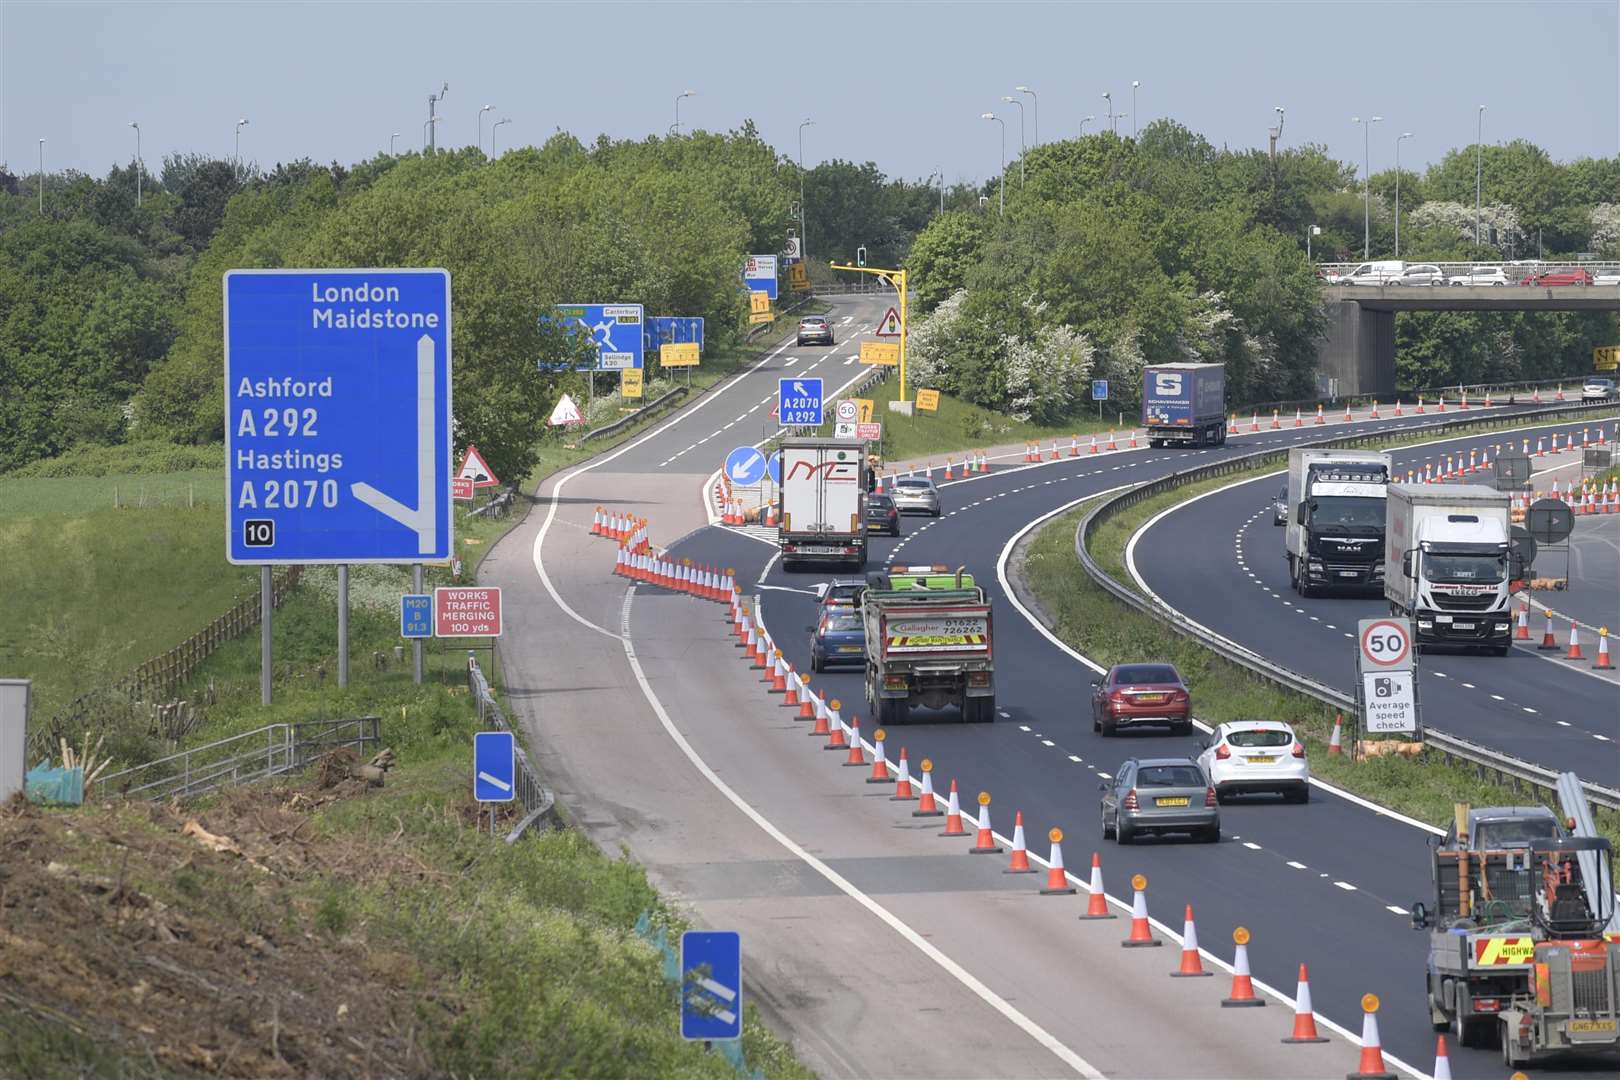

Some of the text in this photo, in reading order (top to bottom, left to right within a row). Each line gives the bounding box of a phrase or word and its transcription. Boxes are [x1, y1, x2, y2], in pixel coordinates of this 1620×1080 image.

[312, 282, 400, 303] London
[312, 308, 440, 329] Maidstone
[604, 354, 632, 362] Sellindge
[237, 377, 333, 398] Ashford
[841, 406, 854, 414] 50
[237, 449, 343, 473] Hastings
[248, 524, 271, 542] 10
[448, 592, 489, 601] WORKS
[406, 600, 429, 609] M20
[446, 601, 491, 610] TRAFFIC
[443, 611, 495, 621] MERGING
[451, 623, 490, 633] 100 yds
[900, 618, 979, 633] Gallagher 01622
[943, 626, 983, 634] 726262
[1370, 634, 1402, 653] 50
[1369, 702, 1411, 711] Average
[1375, 711, 1405, 721] speed
[1376, 721, 1406, 730] check
